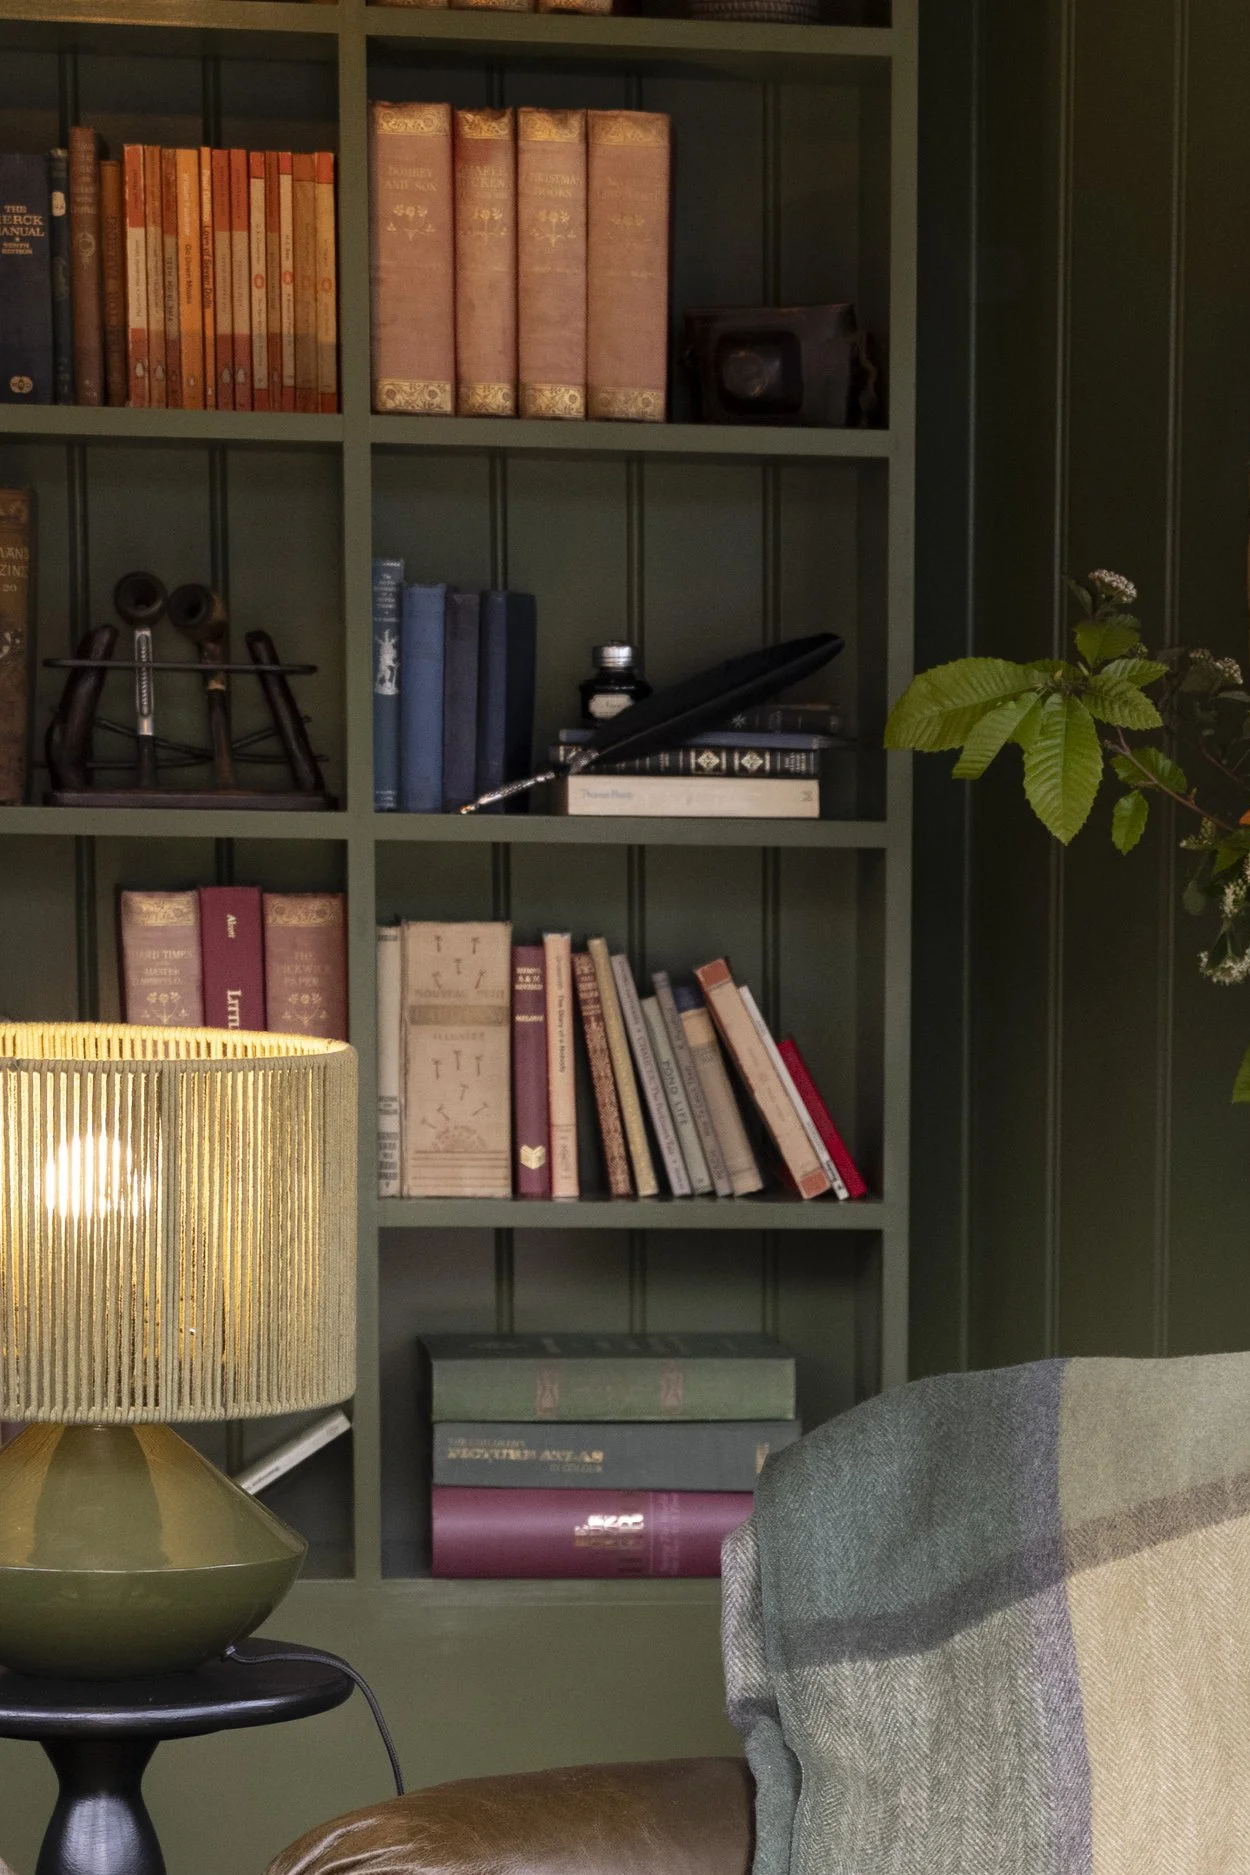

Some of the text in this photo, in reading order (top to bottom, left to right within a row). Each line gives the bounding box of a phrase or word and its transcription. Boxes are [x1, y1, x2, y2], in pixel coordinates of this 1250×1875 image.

[383, 180, 439, 193] AND SON
[4, 205, 28, 213] THE
[0, 215, 48, 225] ERCK
[0, 227, 46, 237] ANUAL
[202, 224, 210, 245] Love
[203, 259, 211, 287] Seven
[204, 287, 212, 309] Dolls
[226, 988, 243, 1028] LITTL
[557, 1009, 565, 1027] Diary
[673, 1099, 689, 1126] LIFE
